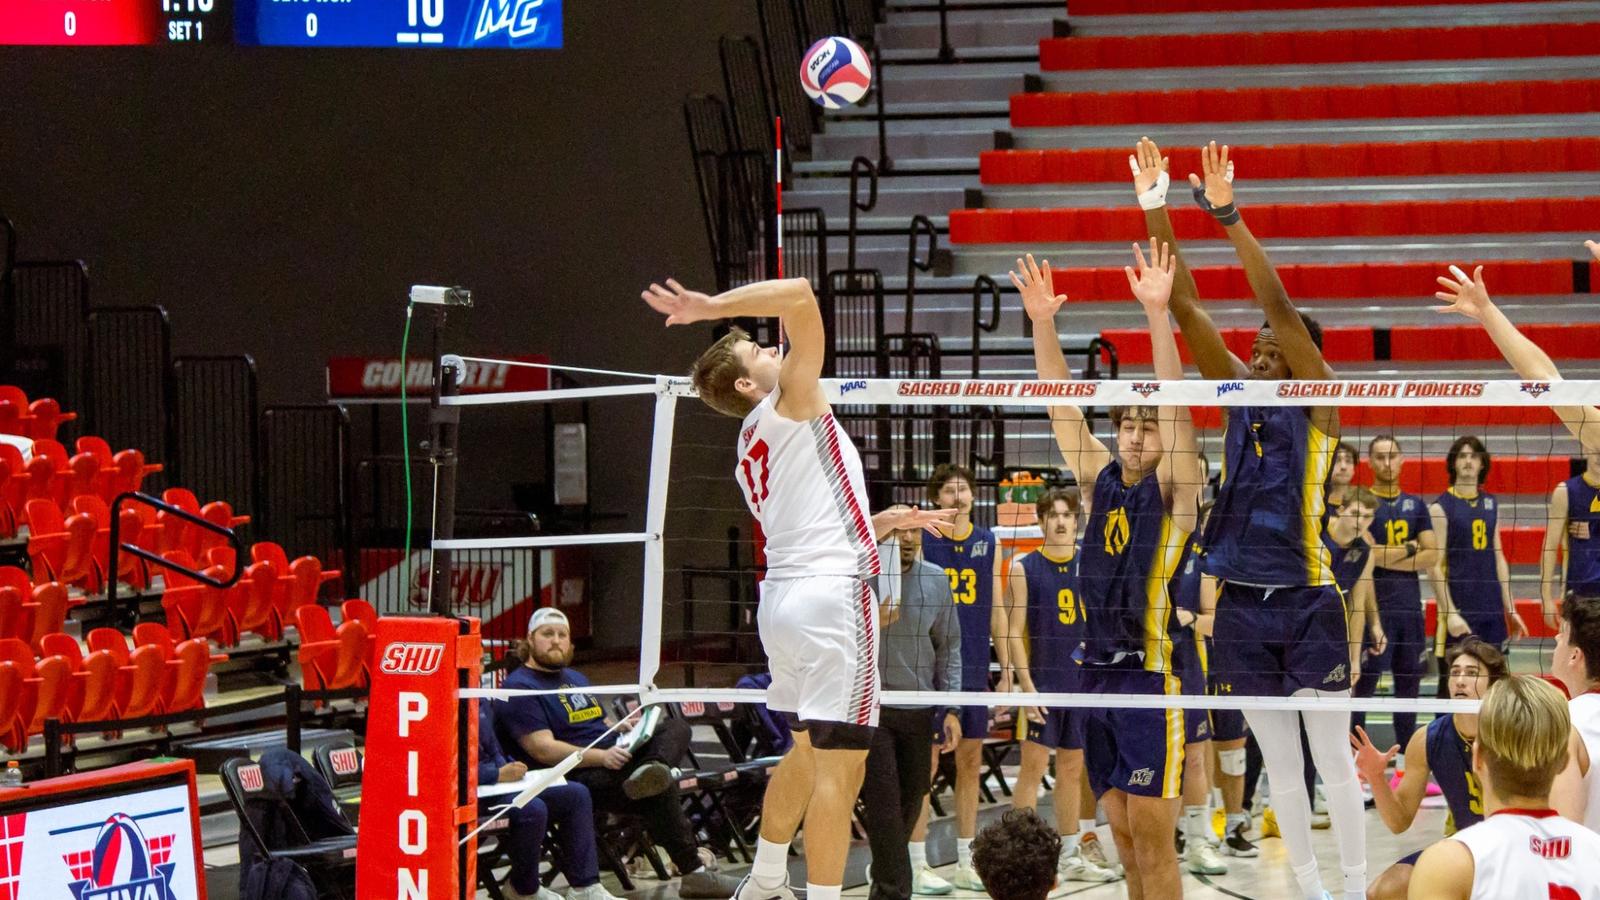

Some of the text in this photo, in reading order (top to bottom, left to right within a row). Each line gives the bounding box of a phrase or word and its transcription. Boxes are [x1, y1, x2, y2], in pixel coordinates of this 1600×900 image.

[64, 11, 77, 37] 0
[168, 20, 203, 41] SET 1
[306, 12, 318, 38] 0
[840, 380, 867, 396] MAAC
[898, 381, 1097, 397] SACRED HEART PIONEERS
[1217, 382, 1244, 397] MAAC
[1277, 382, 1485, 398] SACRED HEART PIONEERS
[741, 438, 769, 512] 17
[1385, 519, 1408, 546] 12
[1472, 519, 1488, 551] 8
[944, 568, 976, 604] 23
[1058, 588, 1077, 624] 9
[380, 642, 446, 674] SHU
[328, 752, 358, 773] SHU
[239, 768, 263, 790] SHU
[1530, 835, 1572, 860] SHU
